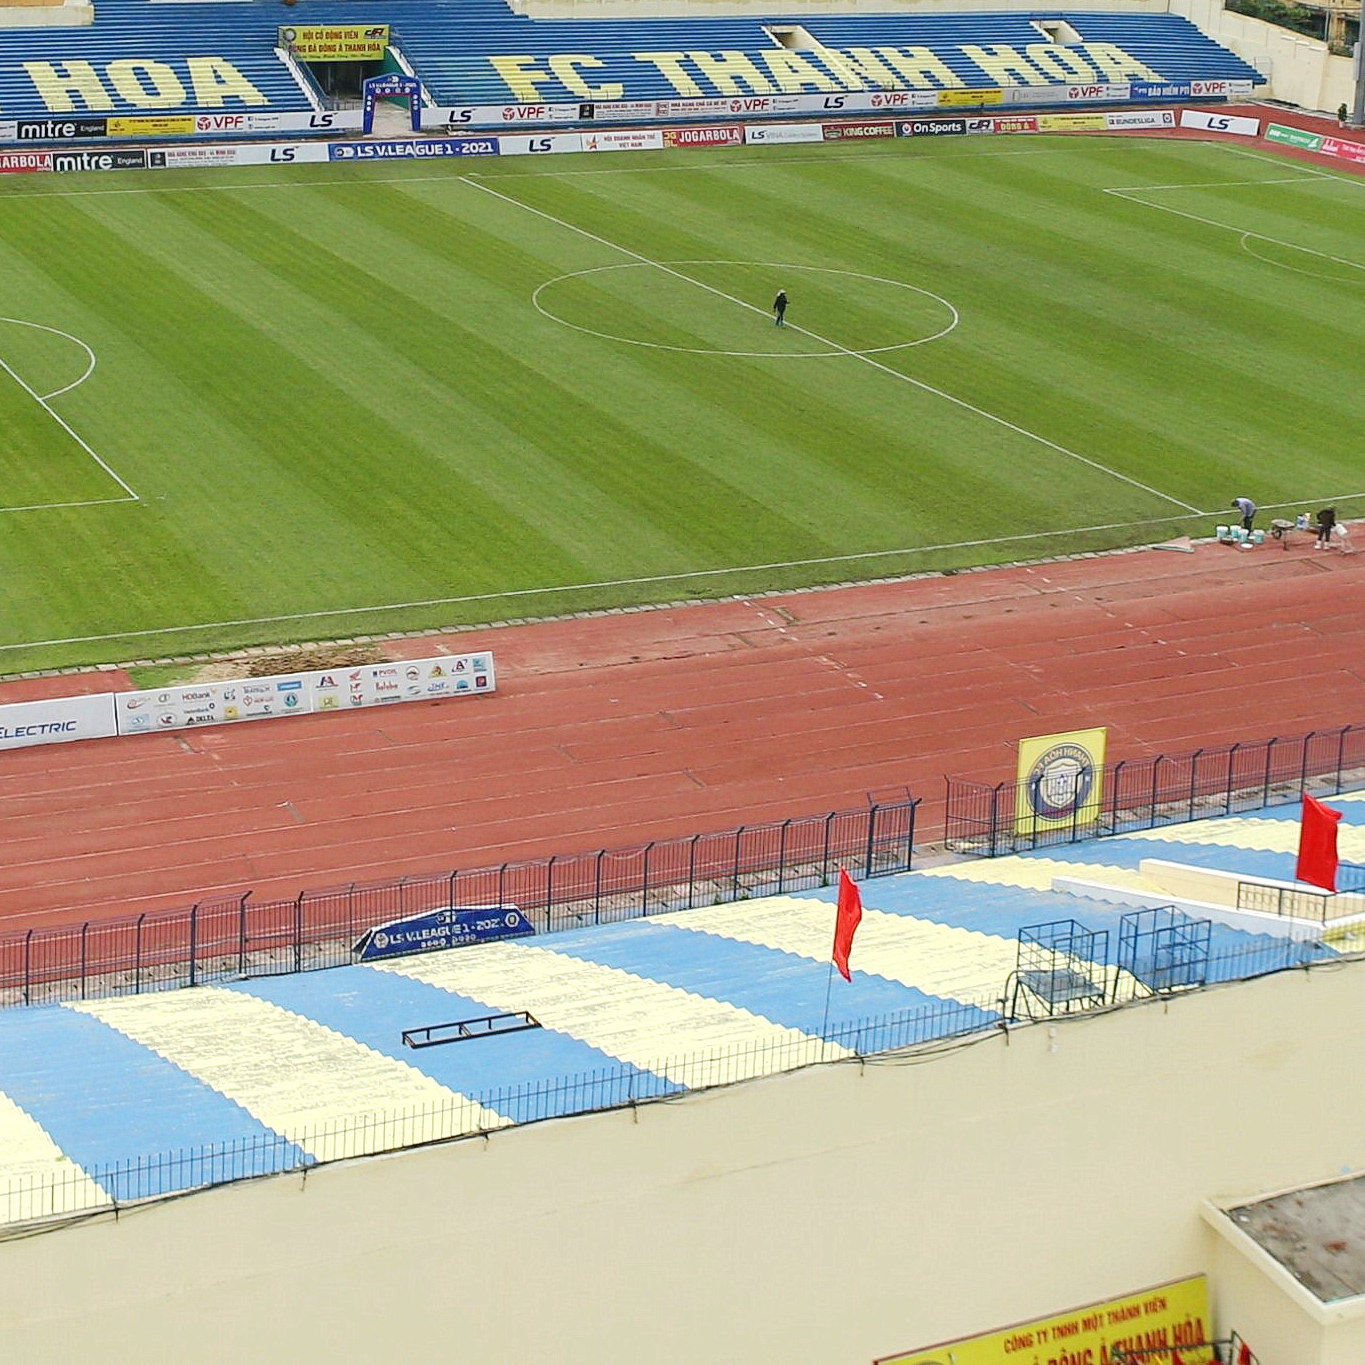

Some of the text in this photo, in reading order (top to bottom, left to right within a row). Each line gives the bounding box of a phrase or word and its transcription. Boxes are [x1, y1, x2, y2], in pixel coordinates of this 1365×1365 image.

[345, 44, 366, 52] THANH
[485, 43, 1171, 103] FC THANH HOA
[22, 56, 272, 111] HOA
[1204, 82, 1226, 93] VPF
[1081, 86, 1103, 97] VPF
[744, 99, 769, 111] VPF
[823, 96, 845, 109] LS
[884, 93, 909, 106] VPF
[448, 109, 472, 123] LS
[517, 106, 546, 119] VPF
[214, 116, 244, 130] VPF
[310, 114, 333, 128] LS
[1116, 117, 1155, 126] BUNDESLIGA
[1207, 117, 1230, 130] LS
[21, 121, 76, 139] mitre
[679, 126, 740, 143] JOGARBOLA
[843, 126, 893, 136] KING COFFEE
[914, 122, 962, 134] OnSports
[751, 130, 766, 140] LS
[357, 142, 494, 156] LS V.LEAGUE 1 2021
[529, 138, 552, 152] LS
[270, 148, 295, 161] LS
[56, 153, 143, 171] mitre England
[390, 934, 405, 945] LS
[463, 923, 470, 933] 1
[1004, 1295, 1168, 1354] CÔNG TY TNHH MỘT THÀNH VIÊN
